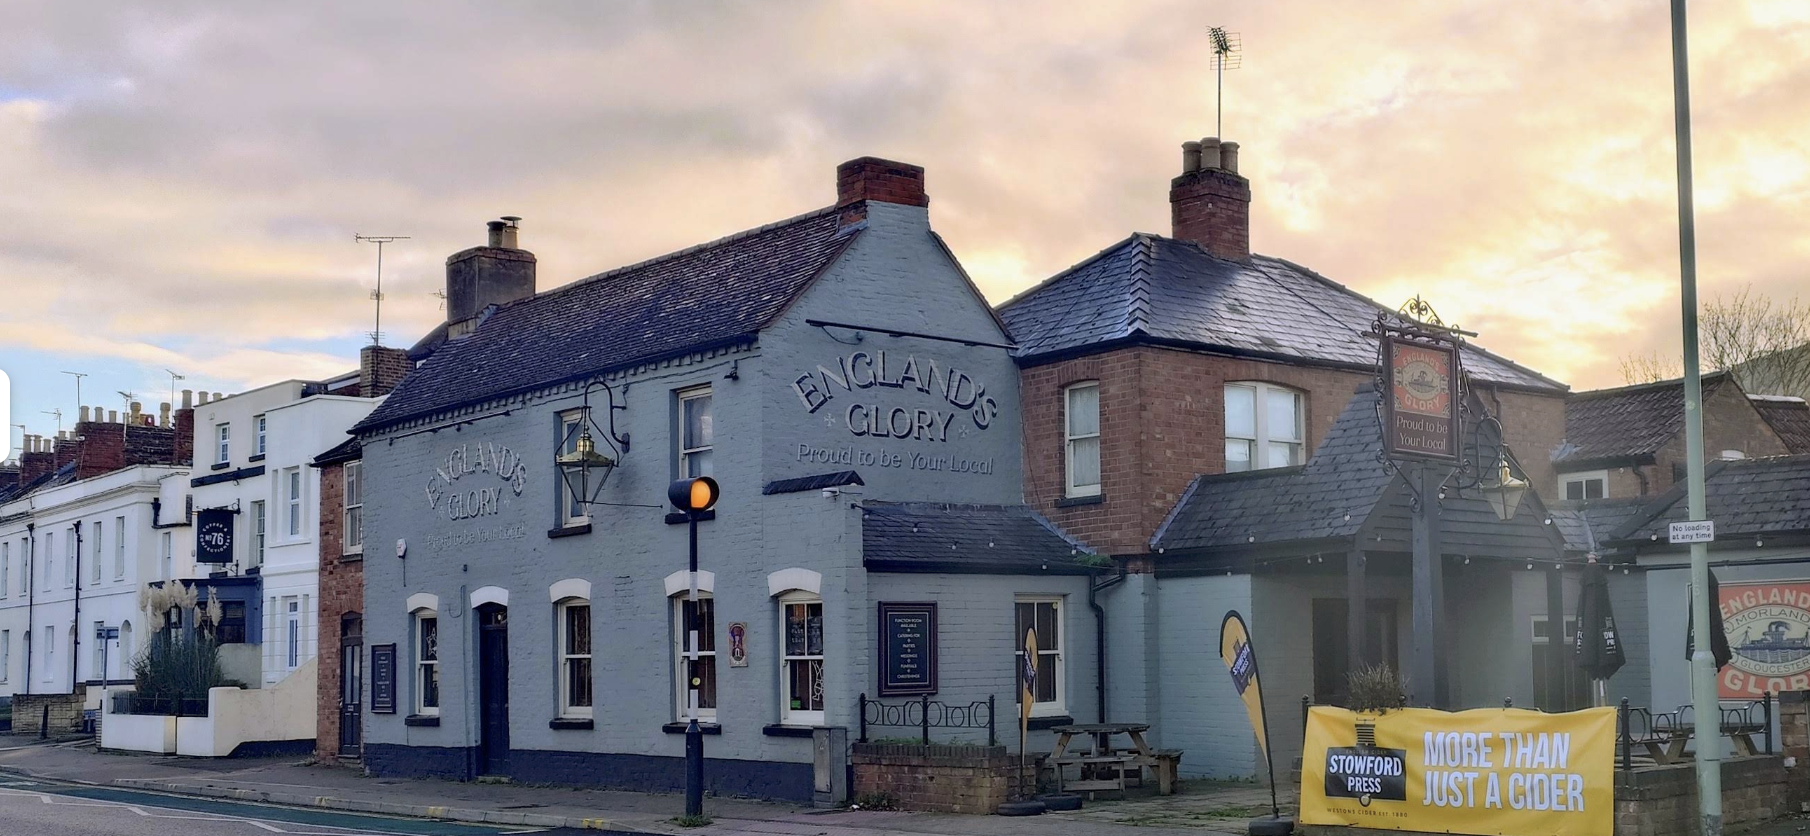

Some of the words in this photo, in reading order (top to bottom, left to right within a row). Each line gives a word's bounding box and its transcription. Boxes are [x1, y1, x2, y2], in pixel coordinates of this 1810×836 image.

[1403, 352, 1440, 371] ENGLAND'S
[790, 350, 998, 430] ENGLAND'S
[1405, 394, 1440, 410] GLORY
[845, 403, 955, 442] GLORY
[1396, 415, 1424, 431] Proud
[1426, 421, 1435, 433] to
[1436, 420, 1448, 433] be
[1400, 432, 1421, 447] Your
[1422, 435, 1446, 450] Local
[796, 442, 853, 466] Proud
[858, 448, 875, 466] to
[880, 448, 902, 468] be
[908, 451, 946, 470] Your
[949, 455, 994, 475] Local
[425, 441, 527, 509] ENGLAND'S
[448, 486, 502, 521] GLORY
[1684, 524, 1711, 532] loading
[211, 532, 224, 545] 76
[1735, 607, 1810, 625] MORLAND
[1740, 657, 1810, 674] GLOUCESTER
[1423, 731, 1493, 768] MORE
[1499, 732, 1570, 769] THAN
[1329, 754, 1403, 776] STOWFORD
[1347, 776, 1382, 793] PRESS
[1422, 770, 1479, 808] JUST
[1485, 772, 1503, 809] A
[1508, 772, 1584, 812] CIDER
[1326, 807, 1356, 815] WESTONS
